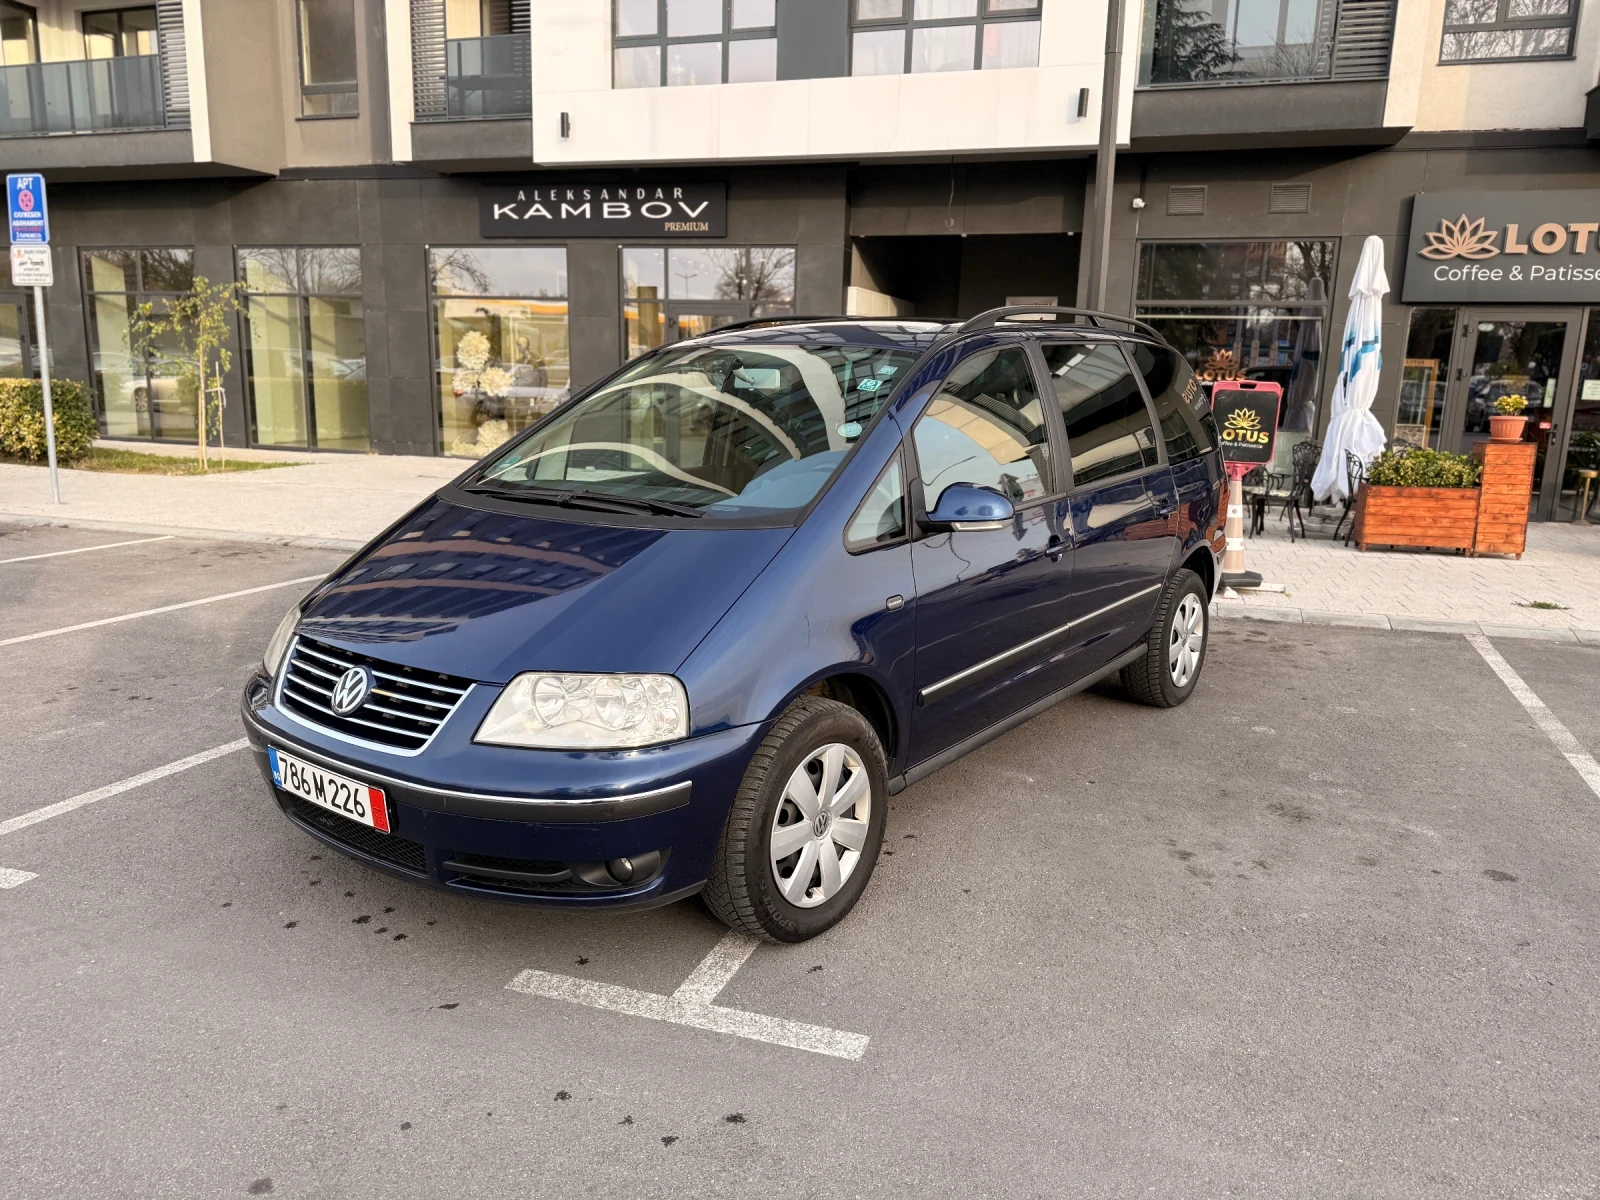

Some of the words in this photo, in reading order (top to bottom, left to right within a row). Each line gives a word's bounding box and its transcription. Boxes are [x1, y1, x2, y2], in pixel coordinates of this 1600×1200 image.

[517, 187, 683, 201] ALEKSANDAR
[493, 201, 709, 220] KAMBOV
[664, 222, 709, 232] PREMIUM
[1503, 222, 1600, 255] LOT
[1434, 264, 1503, 281] Coffee
[1509, 265, 1523, 281] &
[1195, 369, 1247, 381] LOTUS
[1219, 429, 1270, 444] OTUS
[278, 757, 311, 796] 786
[312, 771, 327, 804] M
[328, 779, 366, 818] 226
